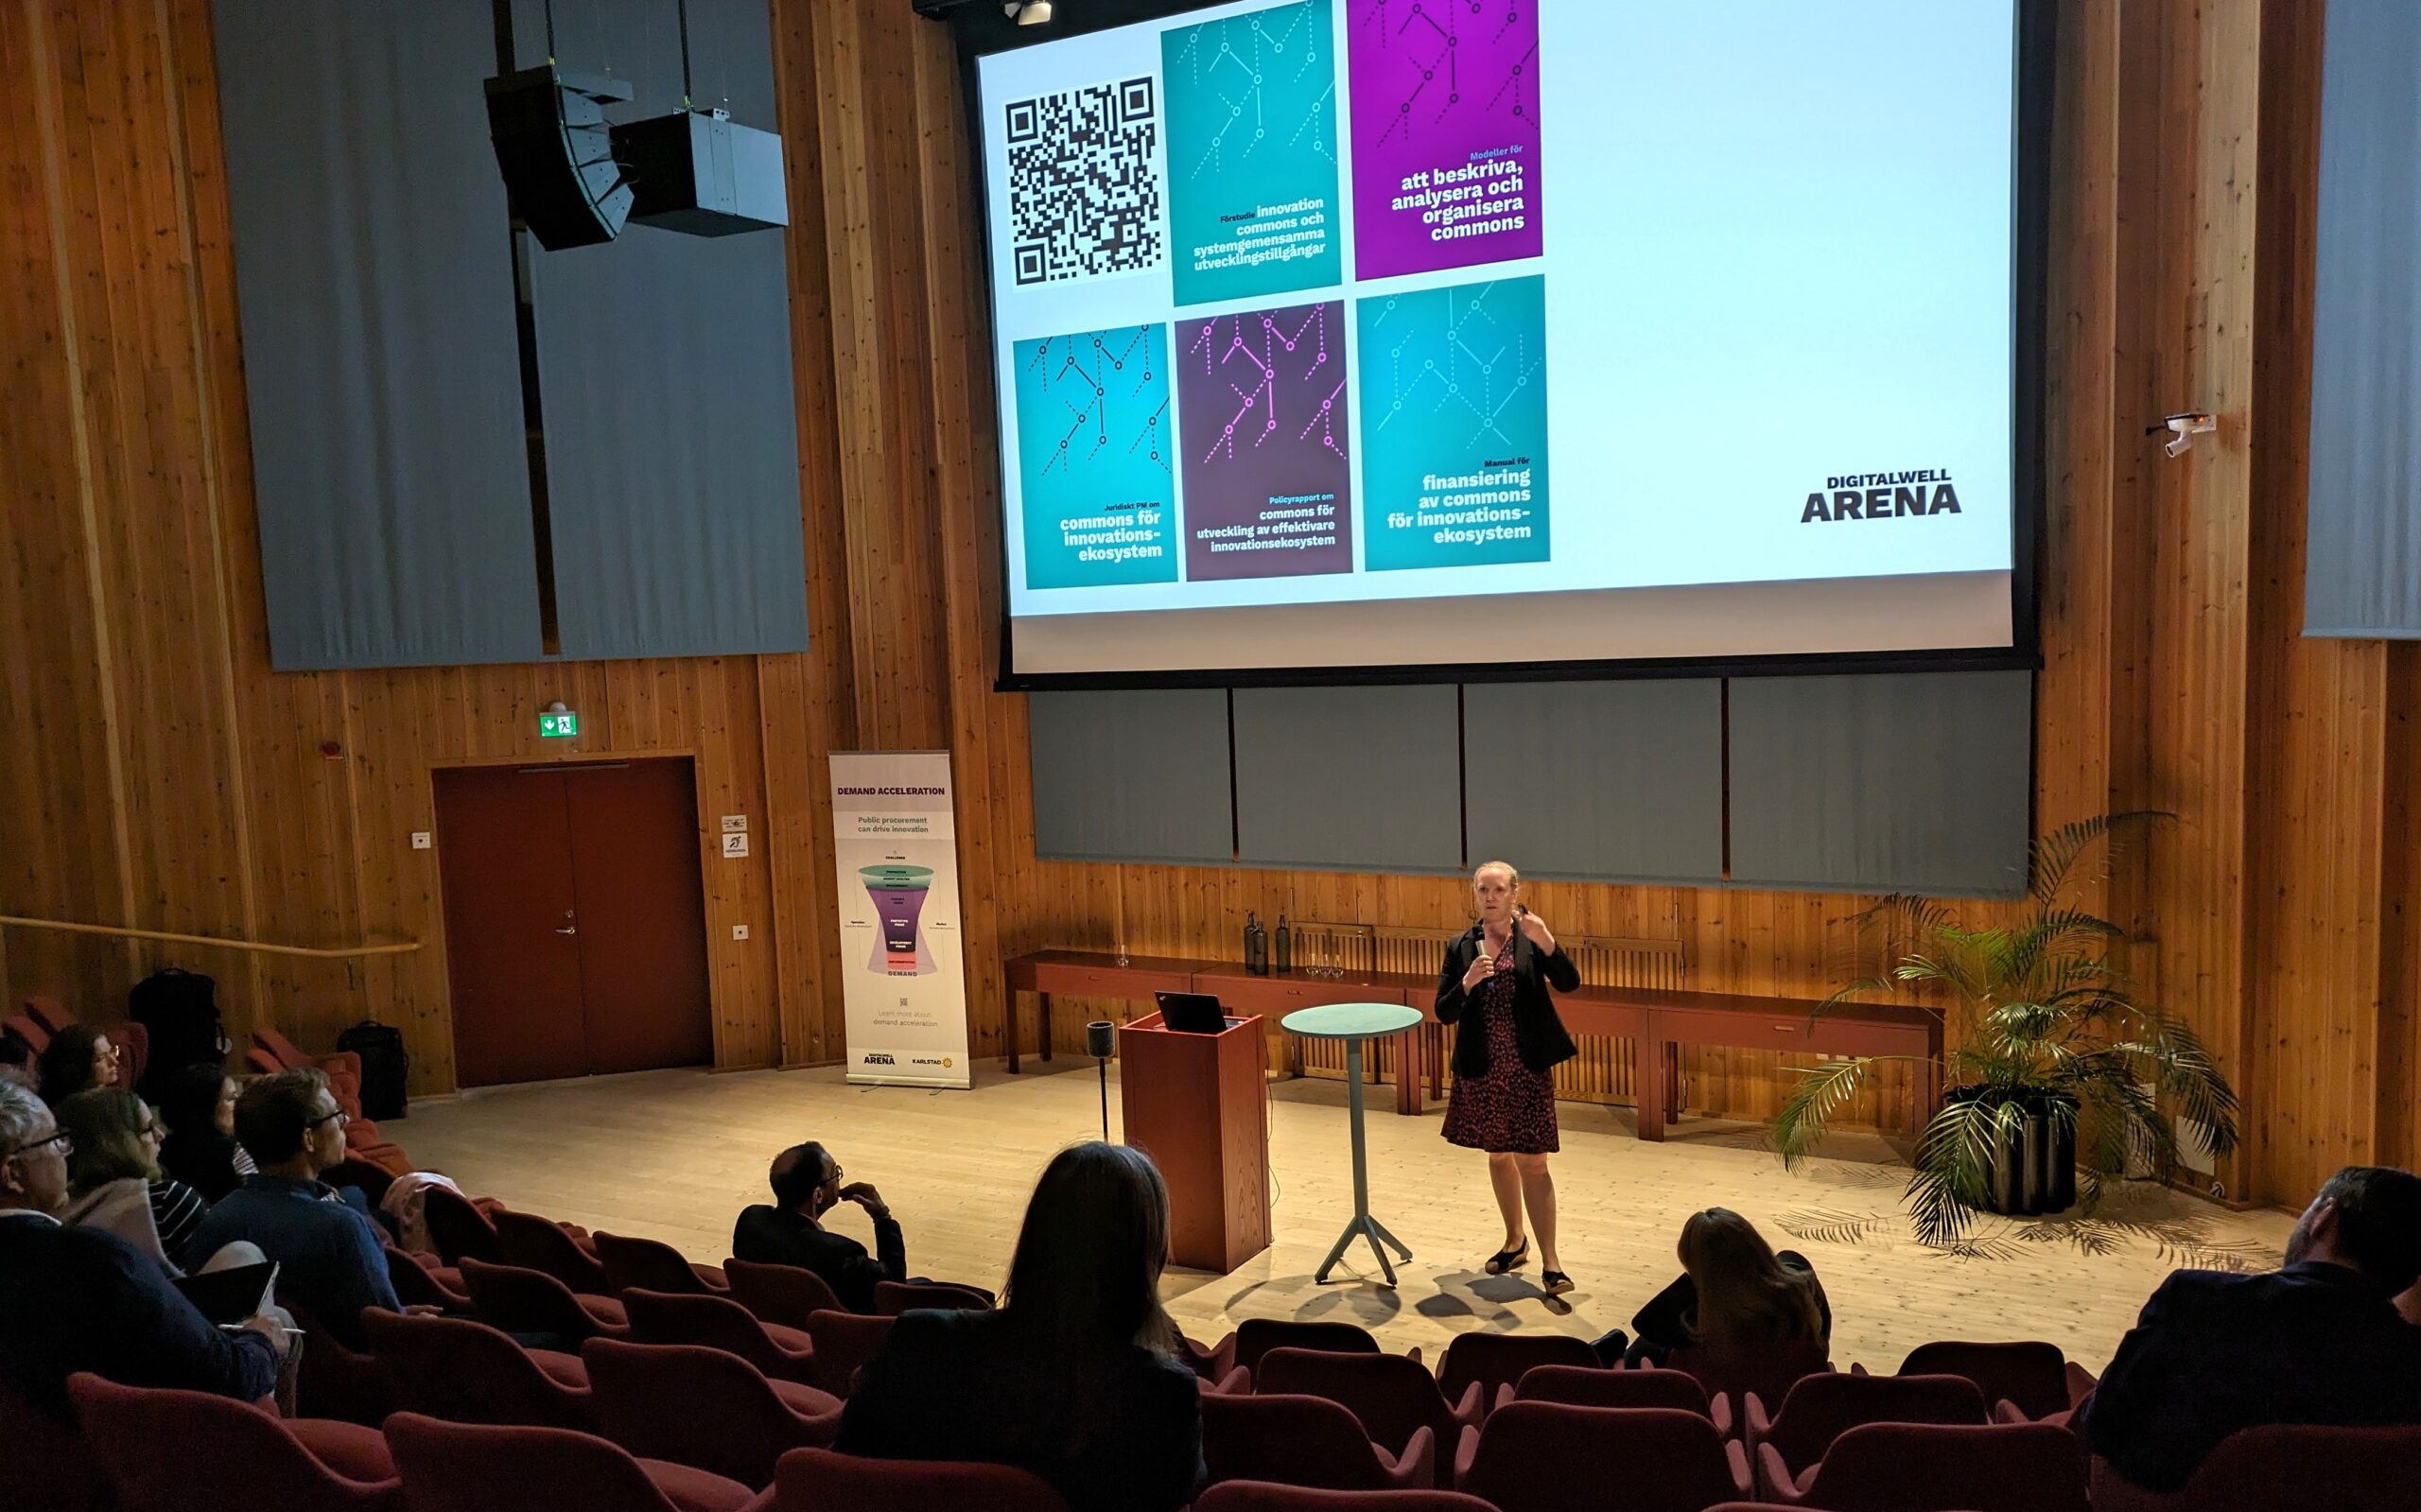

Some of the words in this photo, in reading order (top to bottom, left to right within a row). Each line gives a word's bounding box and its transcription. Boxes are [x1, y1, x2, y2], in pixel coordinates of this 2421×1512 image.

[1470, 148, 1508, 161] Modeller
[1509, 145, 1524, 154] för
[1402, 170, 1429, 191] att
[1434, 159, 1524, 185] beskriva,
[1391, 183, 1483, 211] analysera
[1488, 175, 1524, 195] och
[1220, 212, 1256, 223] Förstudie
[1257, 197, 1324, 218] innovation
[1422, 196, 1524, 226] organisera
[1236, 217, 1298, 236] commons
[1300, 212, 1324, 226] och
[1431, 216, 1524, 241] commons
[1193, 229, 1325, 258] systemgemensamma
[1194, 243, 1326, 271] utvecklingstillgångar
[1484, 458, 1516, 467] Manual
[1517, 457, 1530, 465] för
[1422, 467, 1531, 491] finansiering
[1827, 468, 1952, 489] DIGITALWELL
[1104, 502, 1135, 512] Juridiskt
[1269, 494, 1320, 505] Policyrapport
[1419, 495, 1439, 509] av
[1443, 489, 1531, 508] commons
[1800, 483, 1962, 524] ARENA
[1060, 514, 1134, 530] commons
[1137, 510, 1161, 526] för
[1259, 507, 1315, 520] commons
[1316, 504, 1335, 516] för
[1387, 512, 1414, 529] för
[1417, 506, 1531, 527] innovations-
[1064, 528, 1161, 547] innovations-
[1196, 525, 1255, 539] utveckling
[1257, 524, 1270, 535] av
[1272, 520, 1335, 533] effektivare
[1434, 525, 1531, 545] ekosystem
[1210, 535, 1336, 552] innovationsekosystem
[1078, 544, 1162, 564] ekosystem
[837, 787, 876, 795] DEMAND
[878, 787, 946, 795] ACCELERATION
[881, 817, 928, 826] procurement
[863, 1056, 896, 1066] ARENA
